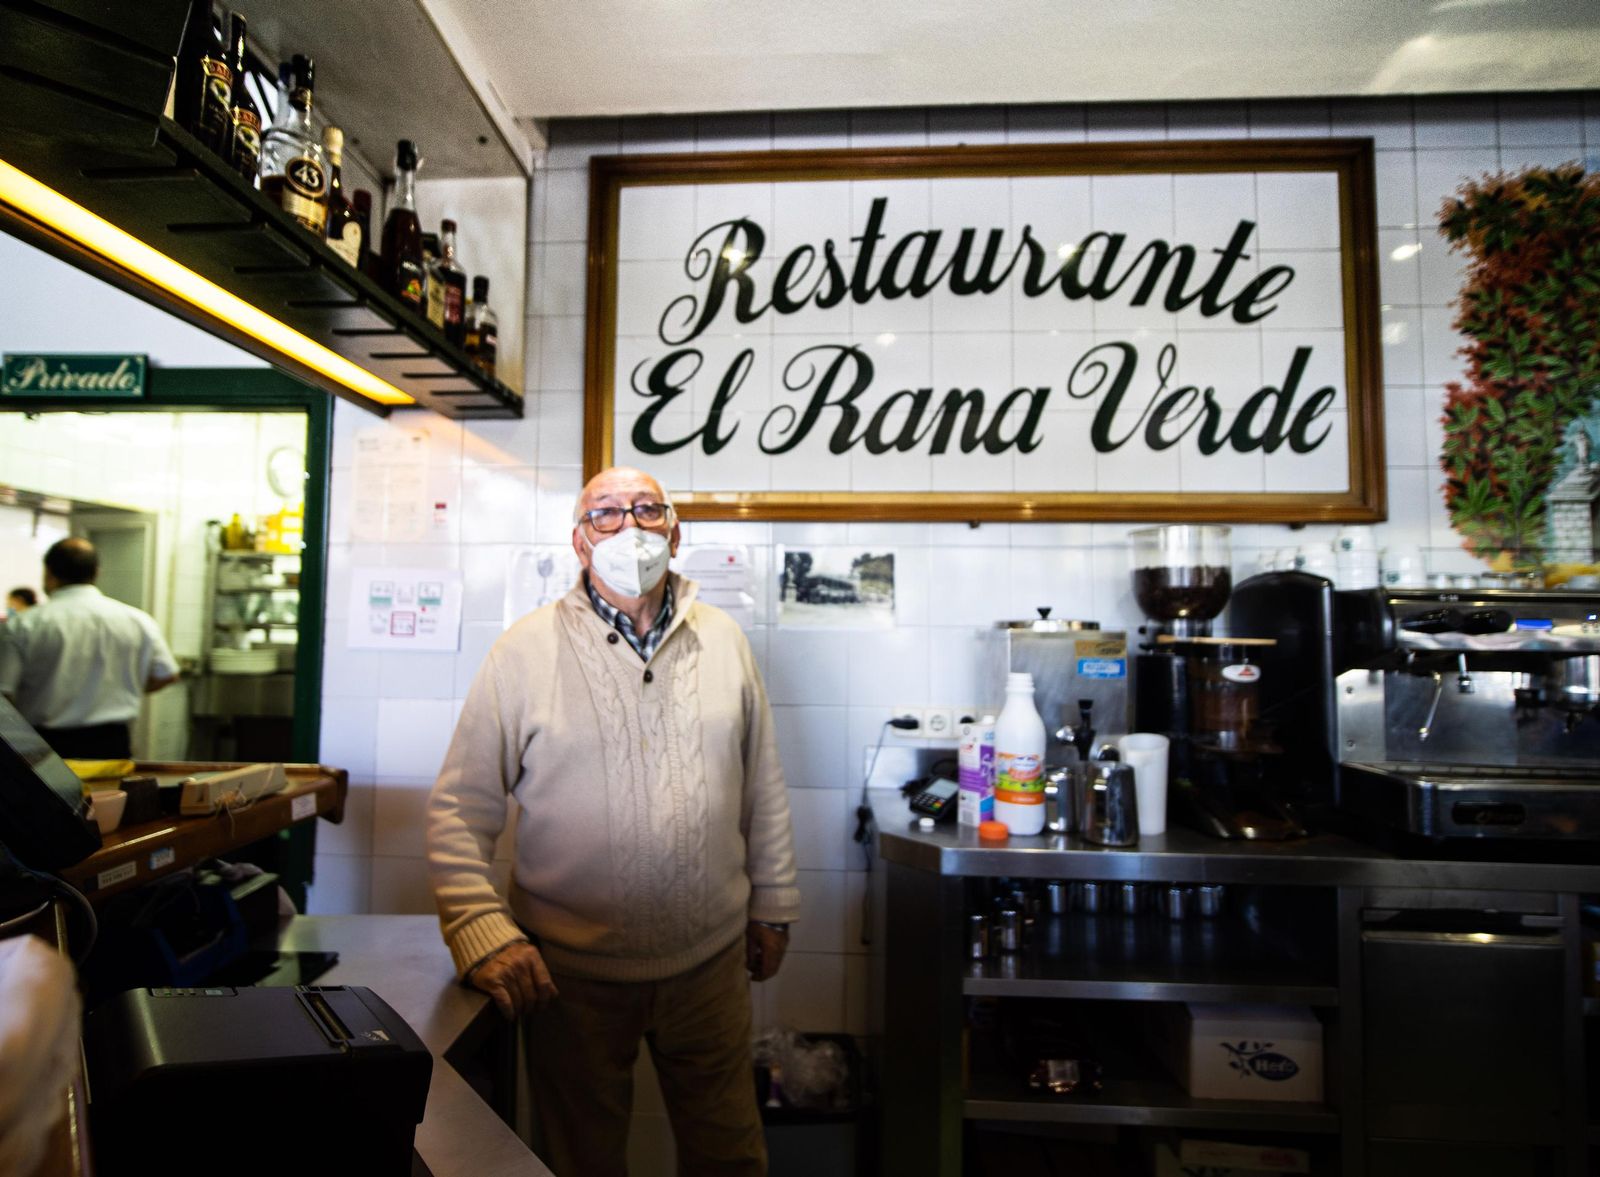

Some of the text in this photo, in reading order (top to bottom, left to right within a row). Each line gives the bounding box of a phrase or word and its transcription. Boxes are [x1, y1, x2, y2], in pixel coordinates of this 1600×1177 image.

[294, 164, 320, 188] 43
[658, 196, 1296, 346] Restaurante
[9, 357, 136, 390] Privado
[630, 341, 1337, 456] El Rana Verde
[1255, 1058, 1297, 1074] Hero
